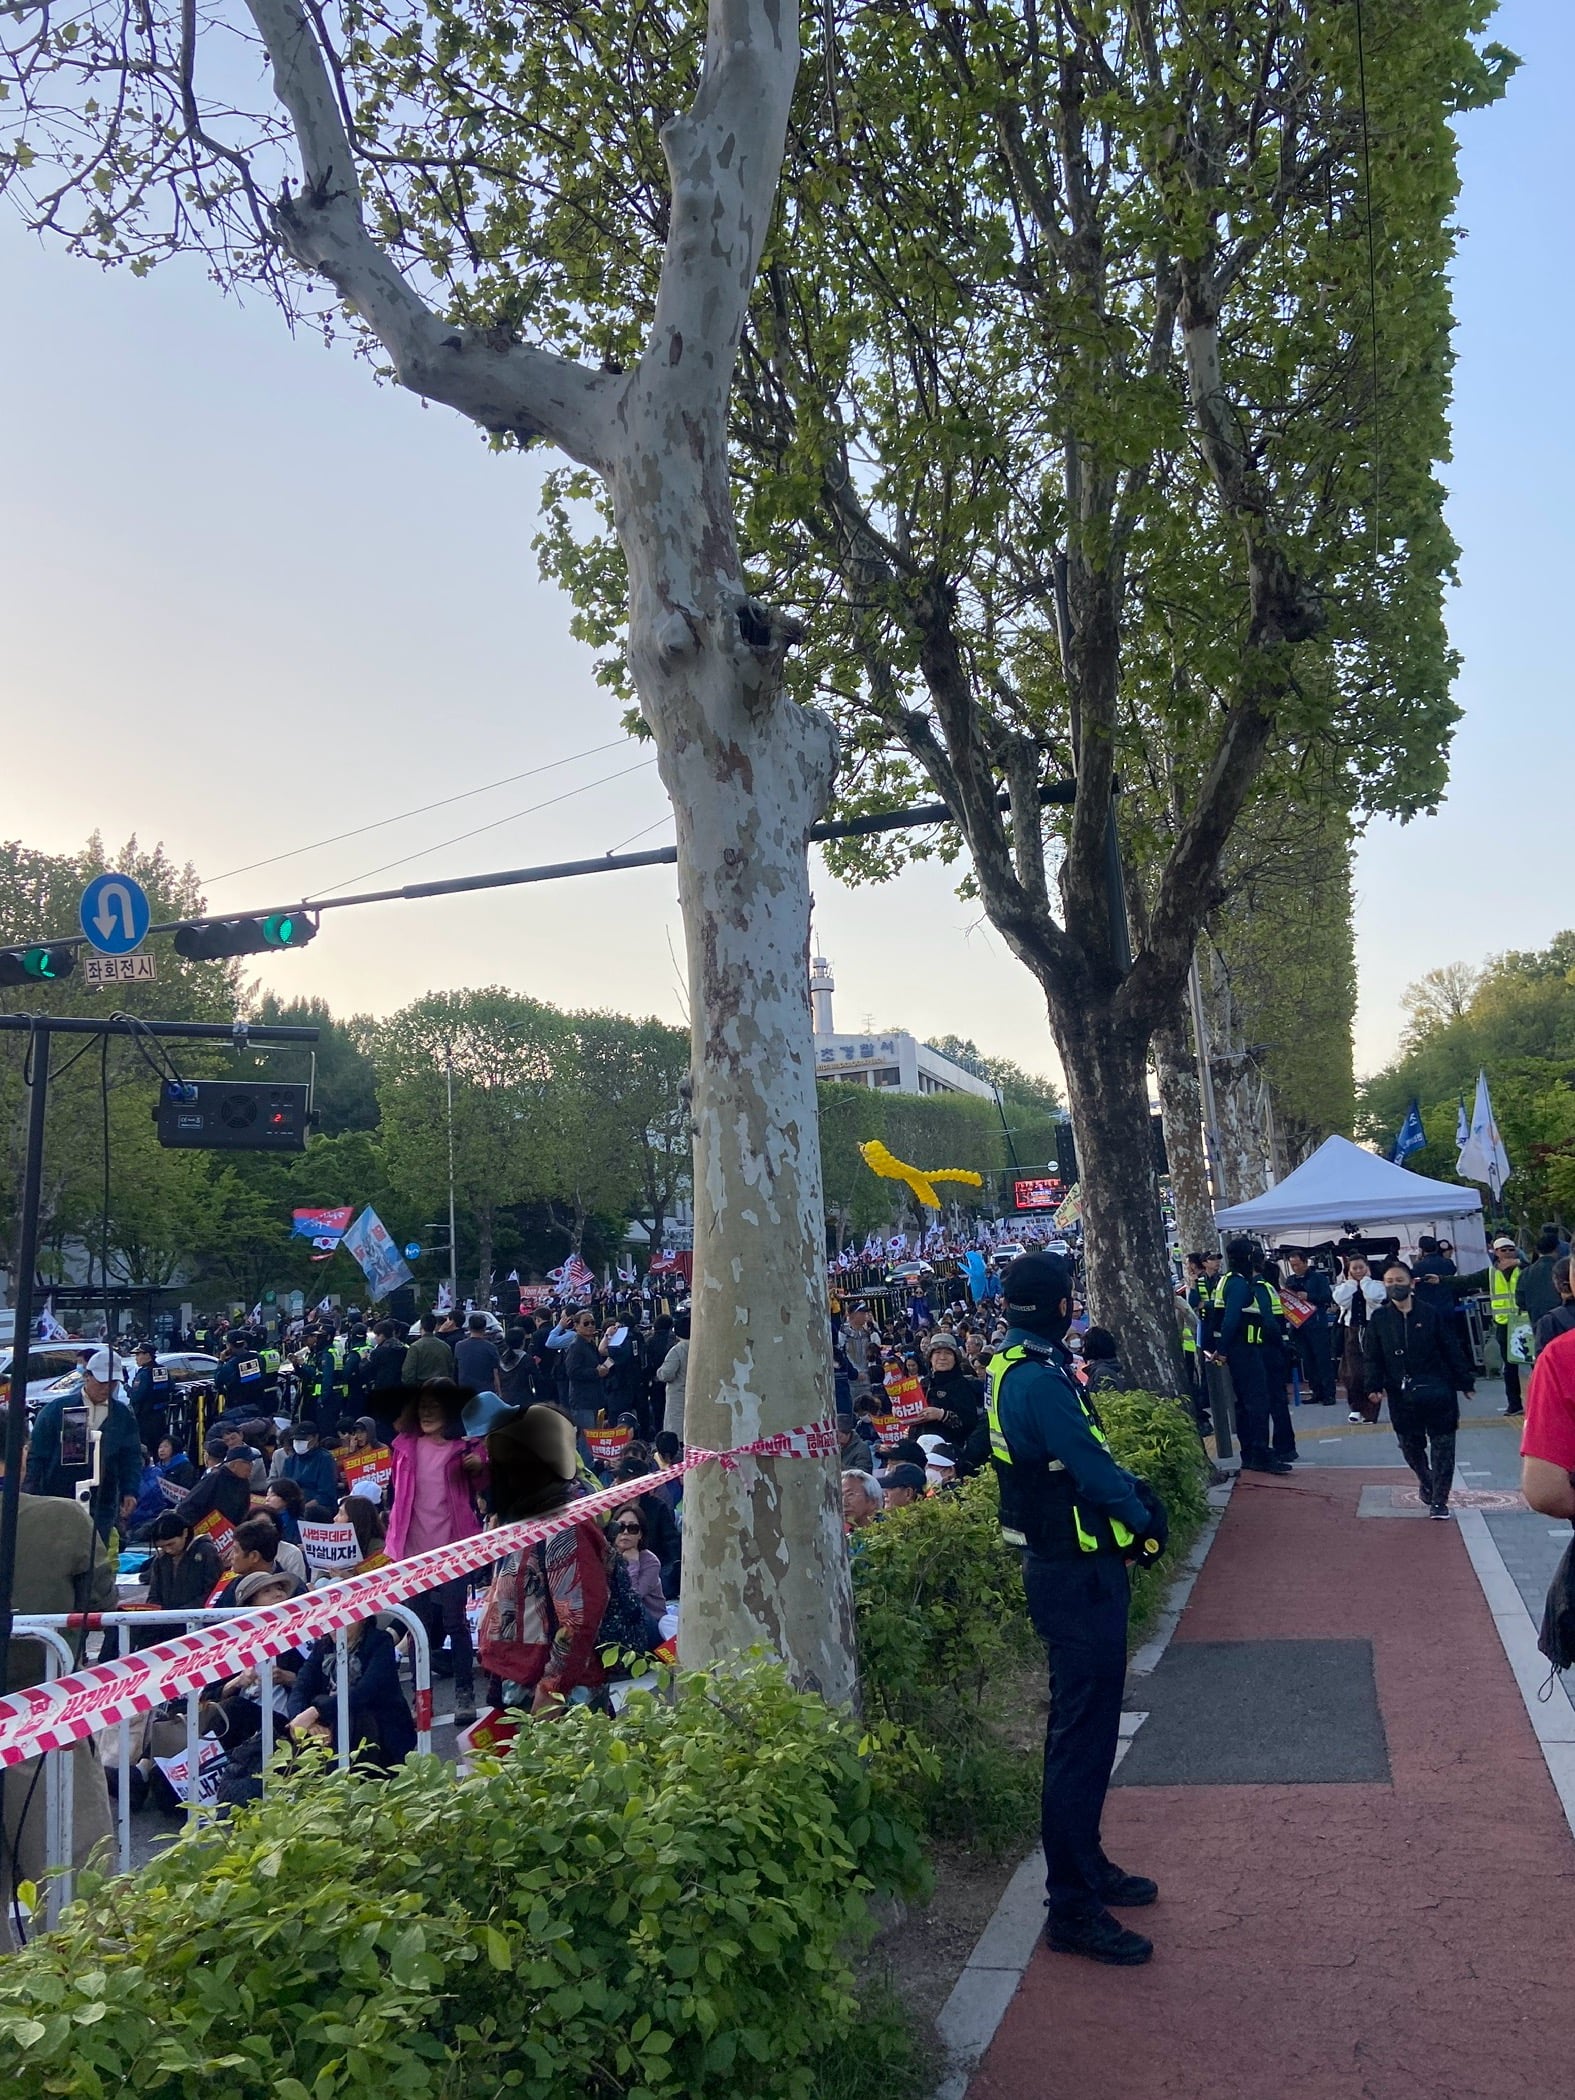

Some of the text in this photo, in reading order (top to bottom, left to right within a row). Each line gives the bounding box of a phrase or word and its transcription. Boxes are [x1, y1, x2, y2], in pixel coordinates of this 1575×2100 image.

[87, 956, 153, 981] 좌회전시
[815, 1040, 895, 1062] 초경찰서
[303, 1527, 353, 1543] 사법쿠데타
[305, 1543, 357, 1562] 박살내자!
[52, 1669, 151, 1727] DANGER!
